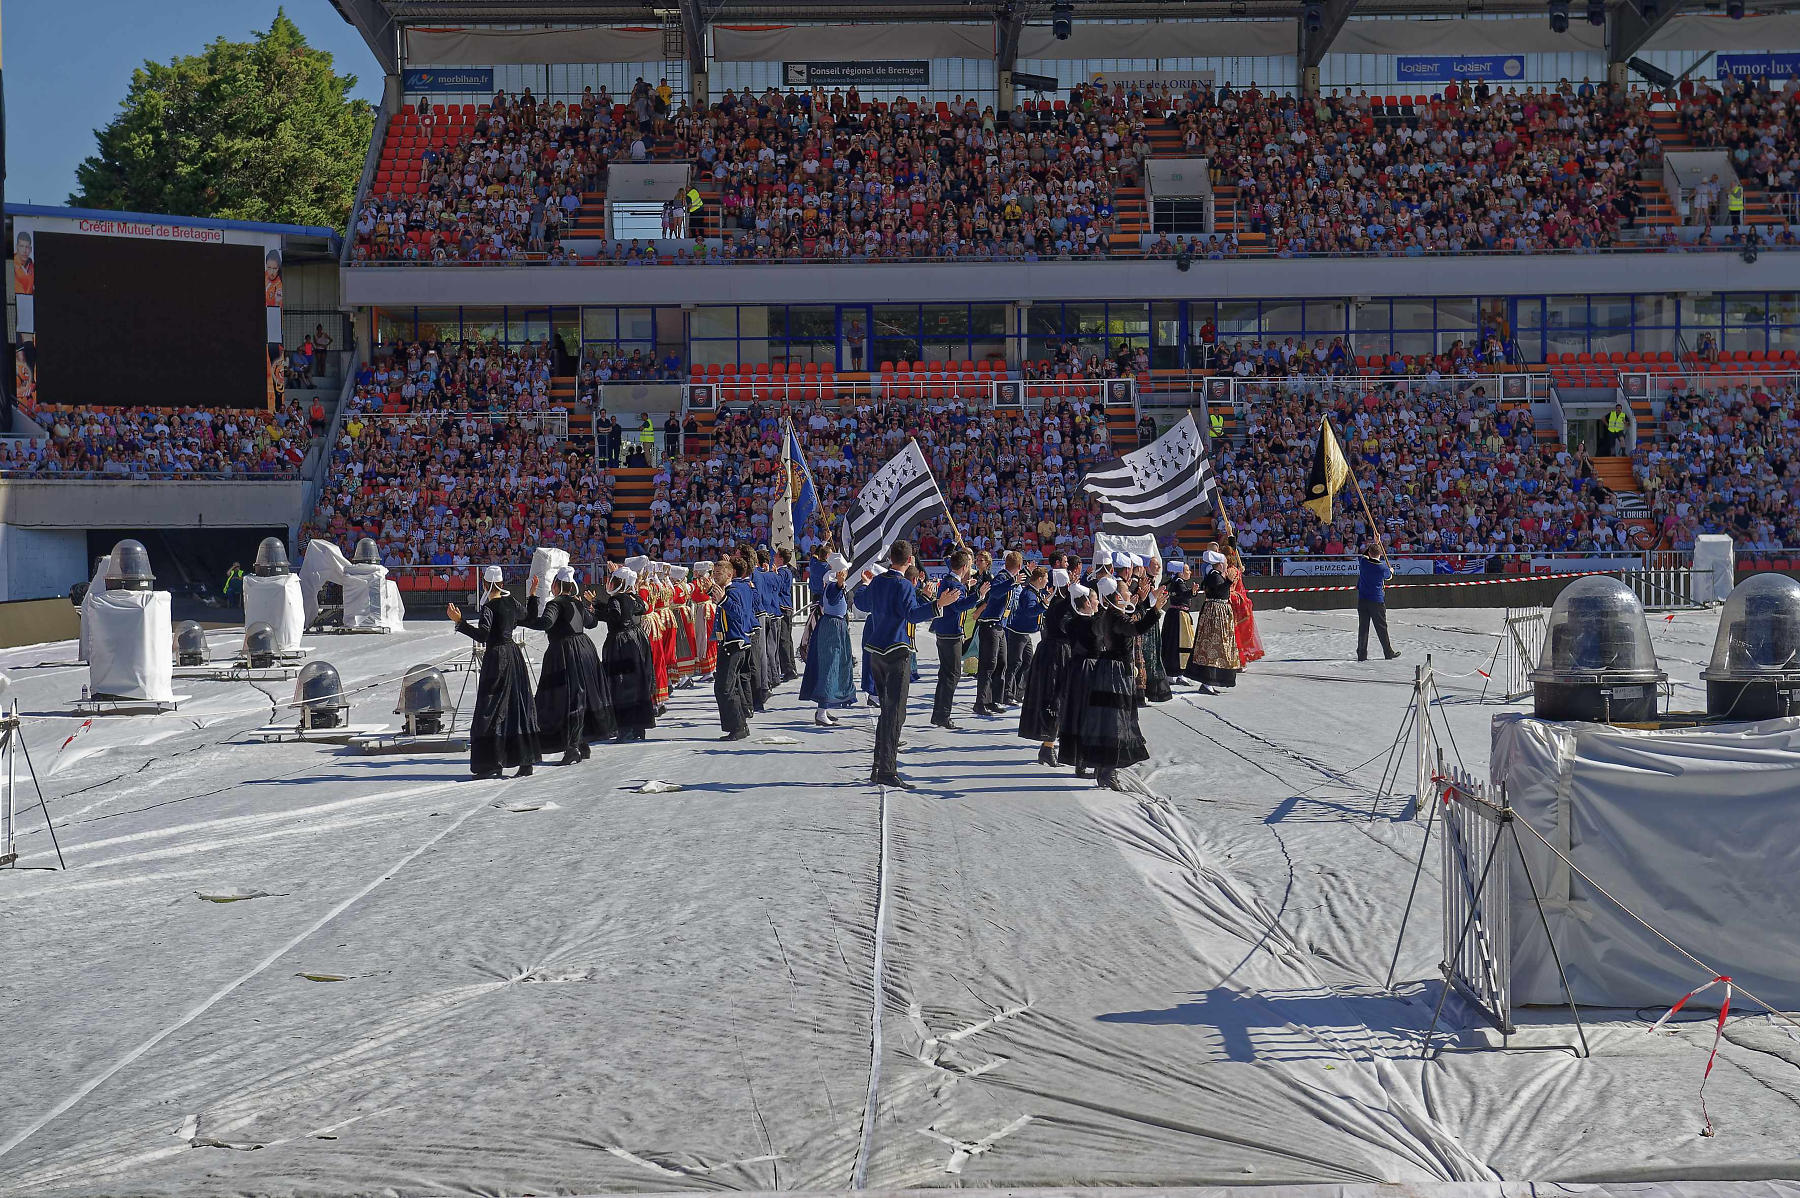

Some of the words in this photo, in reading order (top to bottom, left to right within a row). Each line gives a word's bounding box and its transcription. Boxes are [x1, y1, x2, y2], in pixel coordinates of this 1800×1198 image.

[810, 67, 840, 75] Conseil
[842, 67, 874, 76] régional
[875, 66, 886, 75] de
[888, 66, 924, 76] Bretagne
[438, 75, 489, 83] morbihan.fr
[81, 219, 114, 233] Crédit
[117, 222, 154, 236] Mutuel
[156, 225, 170, 237] de
[172, 226, 221, 242] Bretagne
[1623, 510, 1652, 519] LORIENT
